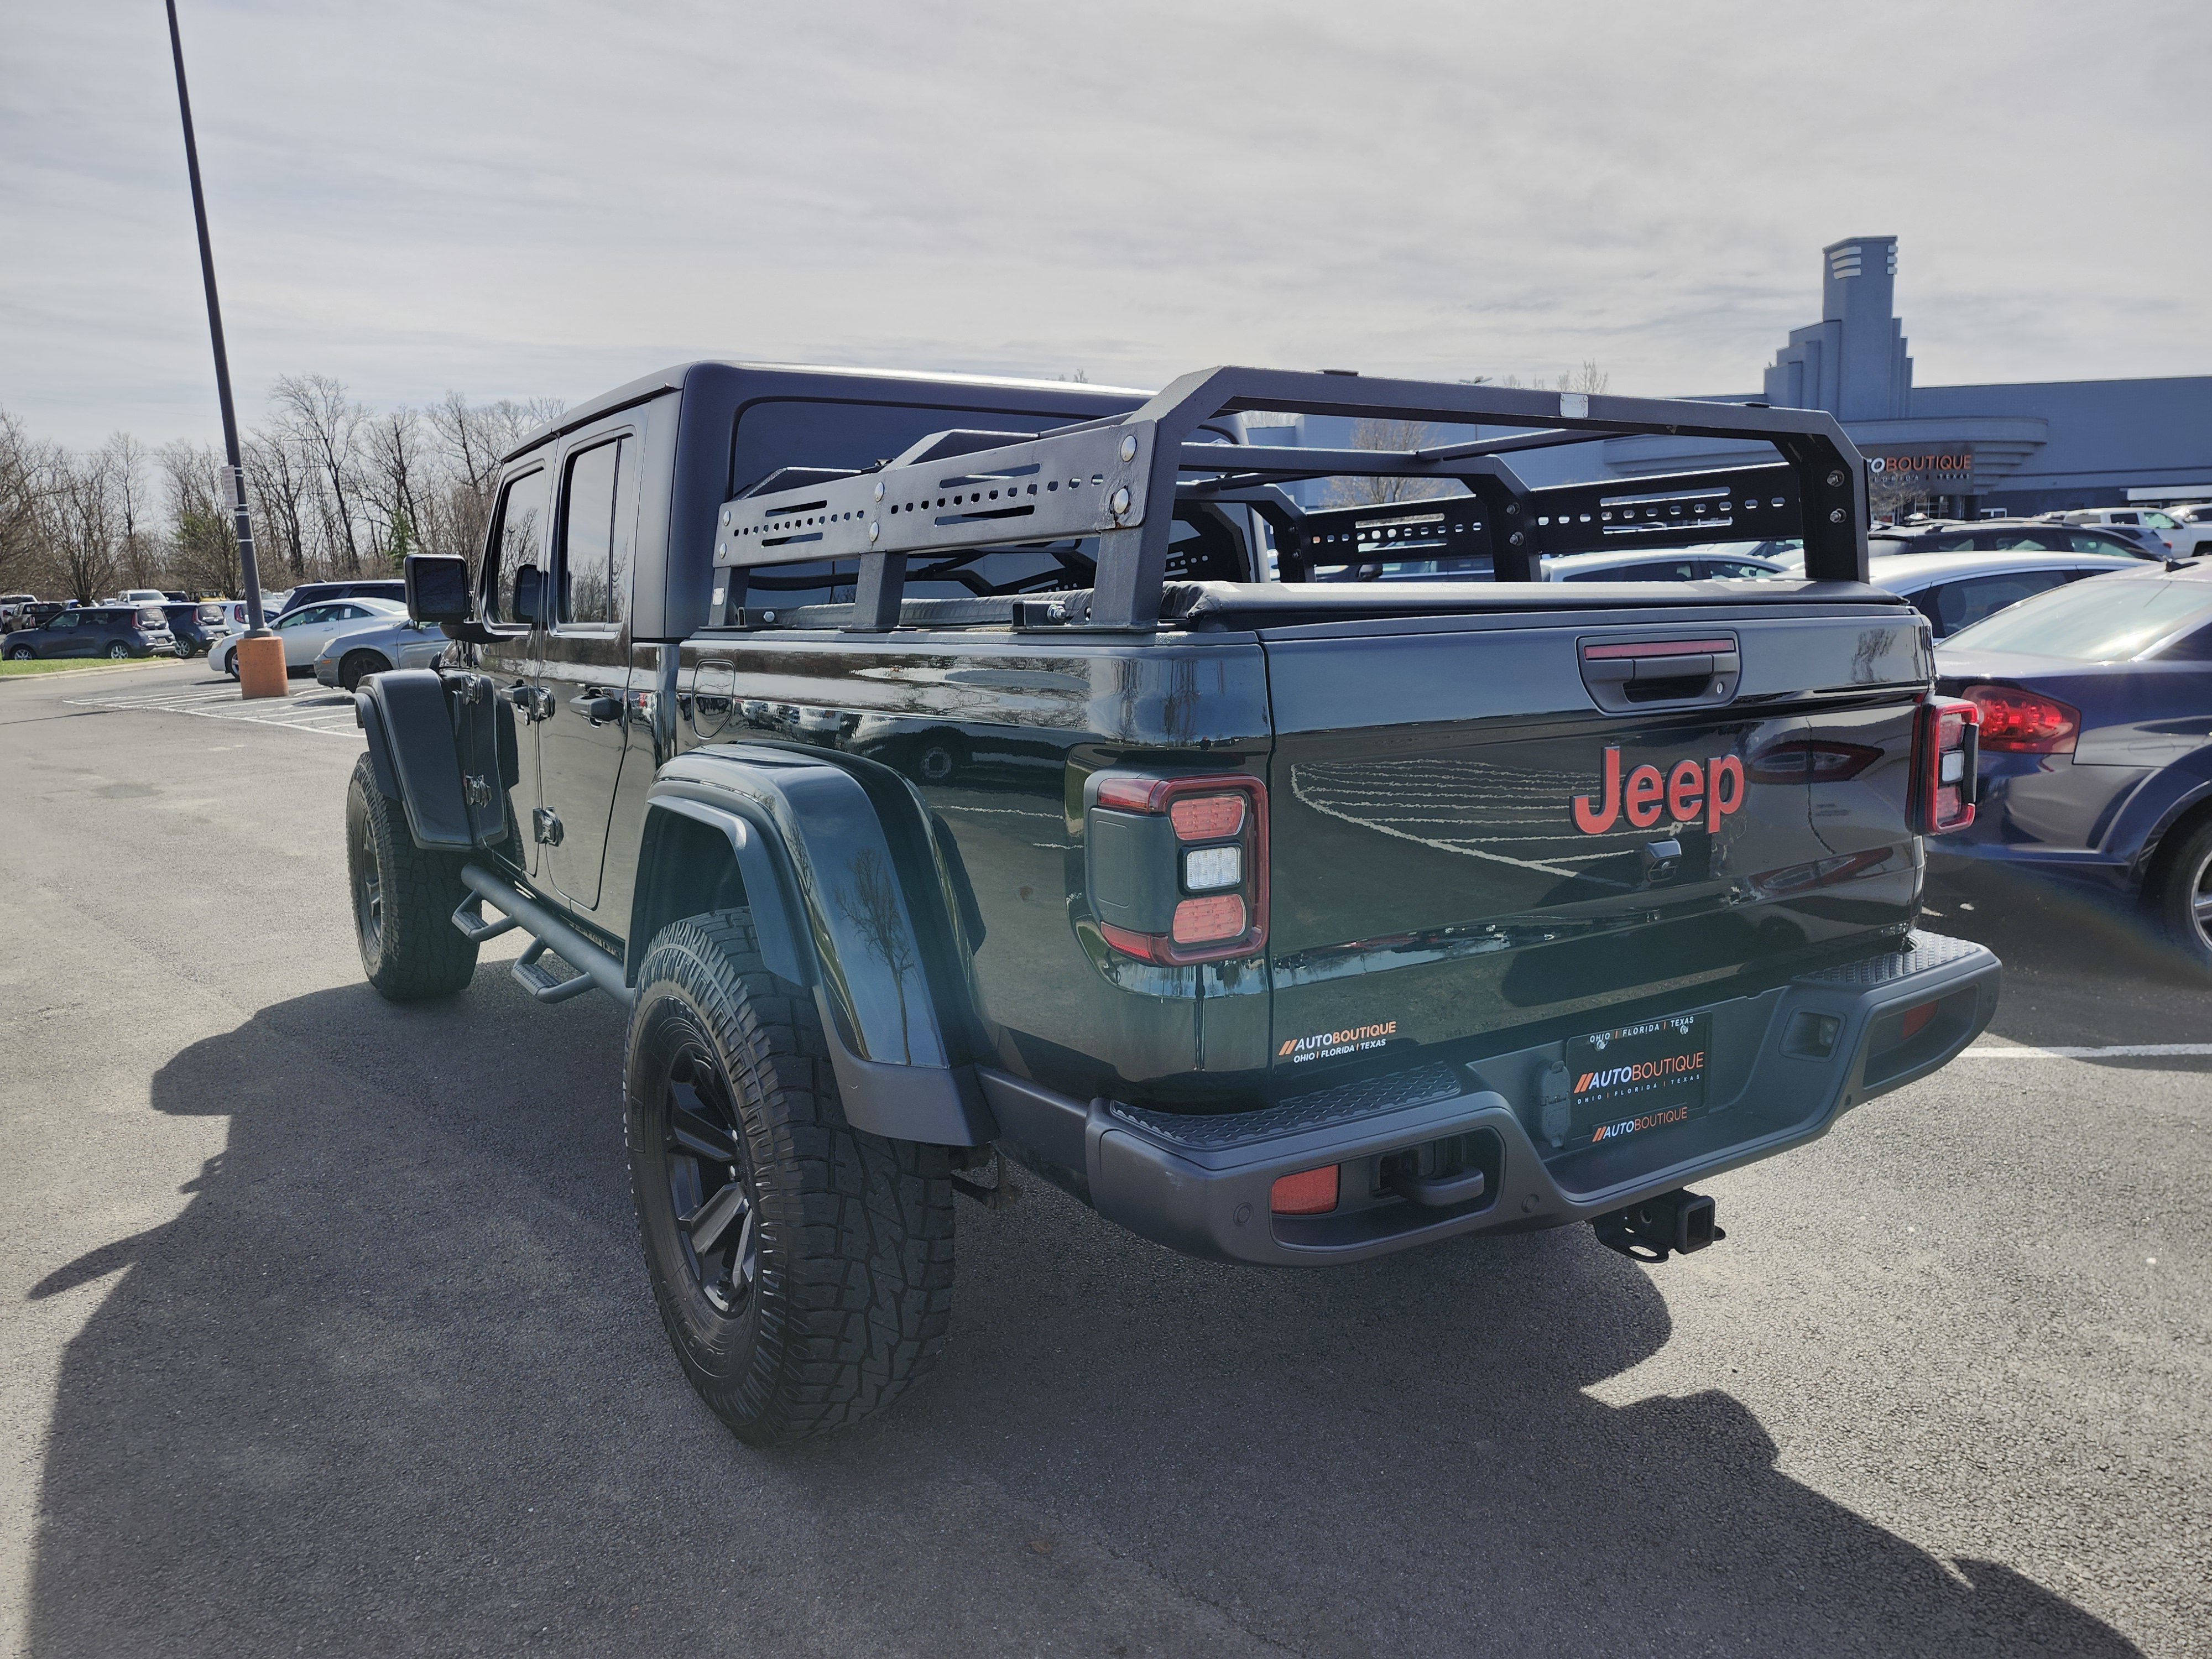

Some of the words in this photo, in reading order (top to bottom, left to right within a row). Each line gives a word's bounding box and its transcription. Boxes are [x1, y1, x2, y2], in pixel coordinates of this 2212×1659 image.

[1867, 454, 1971, 473] OBOUTIQUE
[1569, 745, 1744, 834] Jeep
[1295, 1021, 1396, 1051] AUTOBOUTIQUE
[1590, 1032, 1610, 1043] OHIO
[1622, 1023, 1660, 1037] FLORIDA
[1670, 1016, 1694, 1027] TEXAS
[1293, 1052, 1315, 1063] OHIO
[1321, 1045, 1355, 1058] FLORIDA
[1360, 1039, 1386, 1050] TEXAS
[1588, 1052, 1704, 1089] AUTOBOUTIQUE
[1577, 1094, 1601, 1104] OHIO
[1614, 1083, 1658, 1097] FLORIDA
[1671, 1074, 1700, 1085] TEXAS
[1603, 1107, 1688, 1139] AUTOBOUTIQUE
